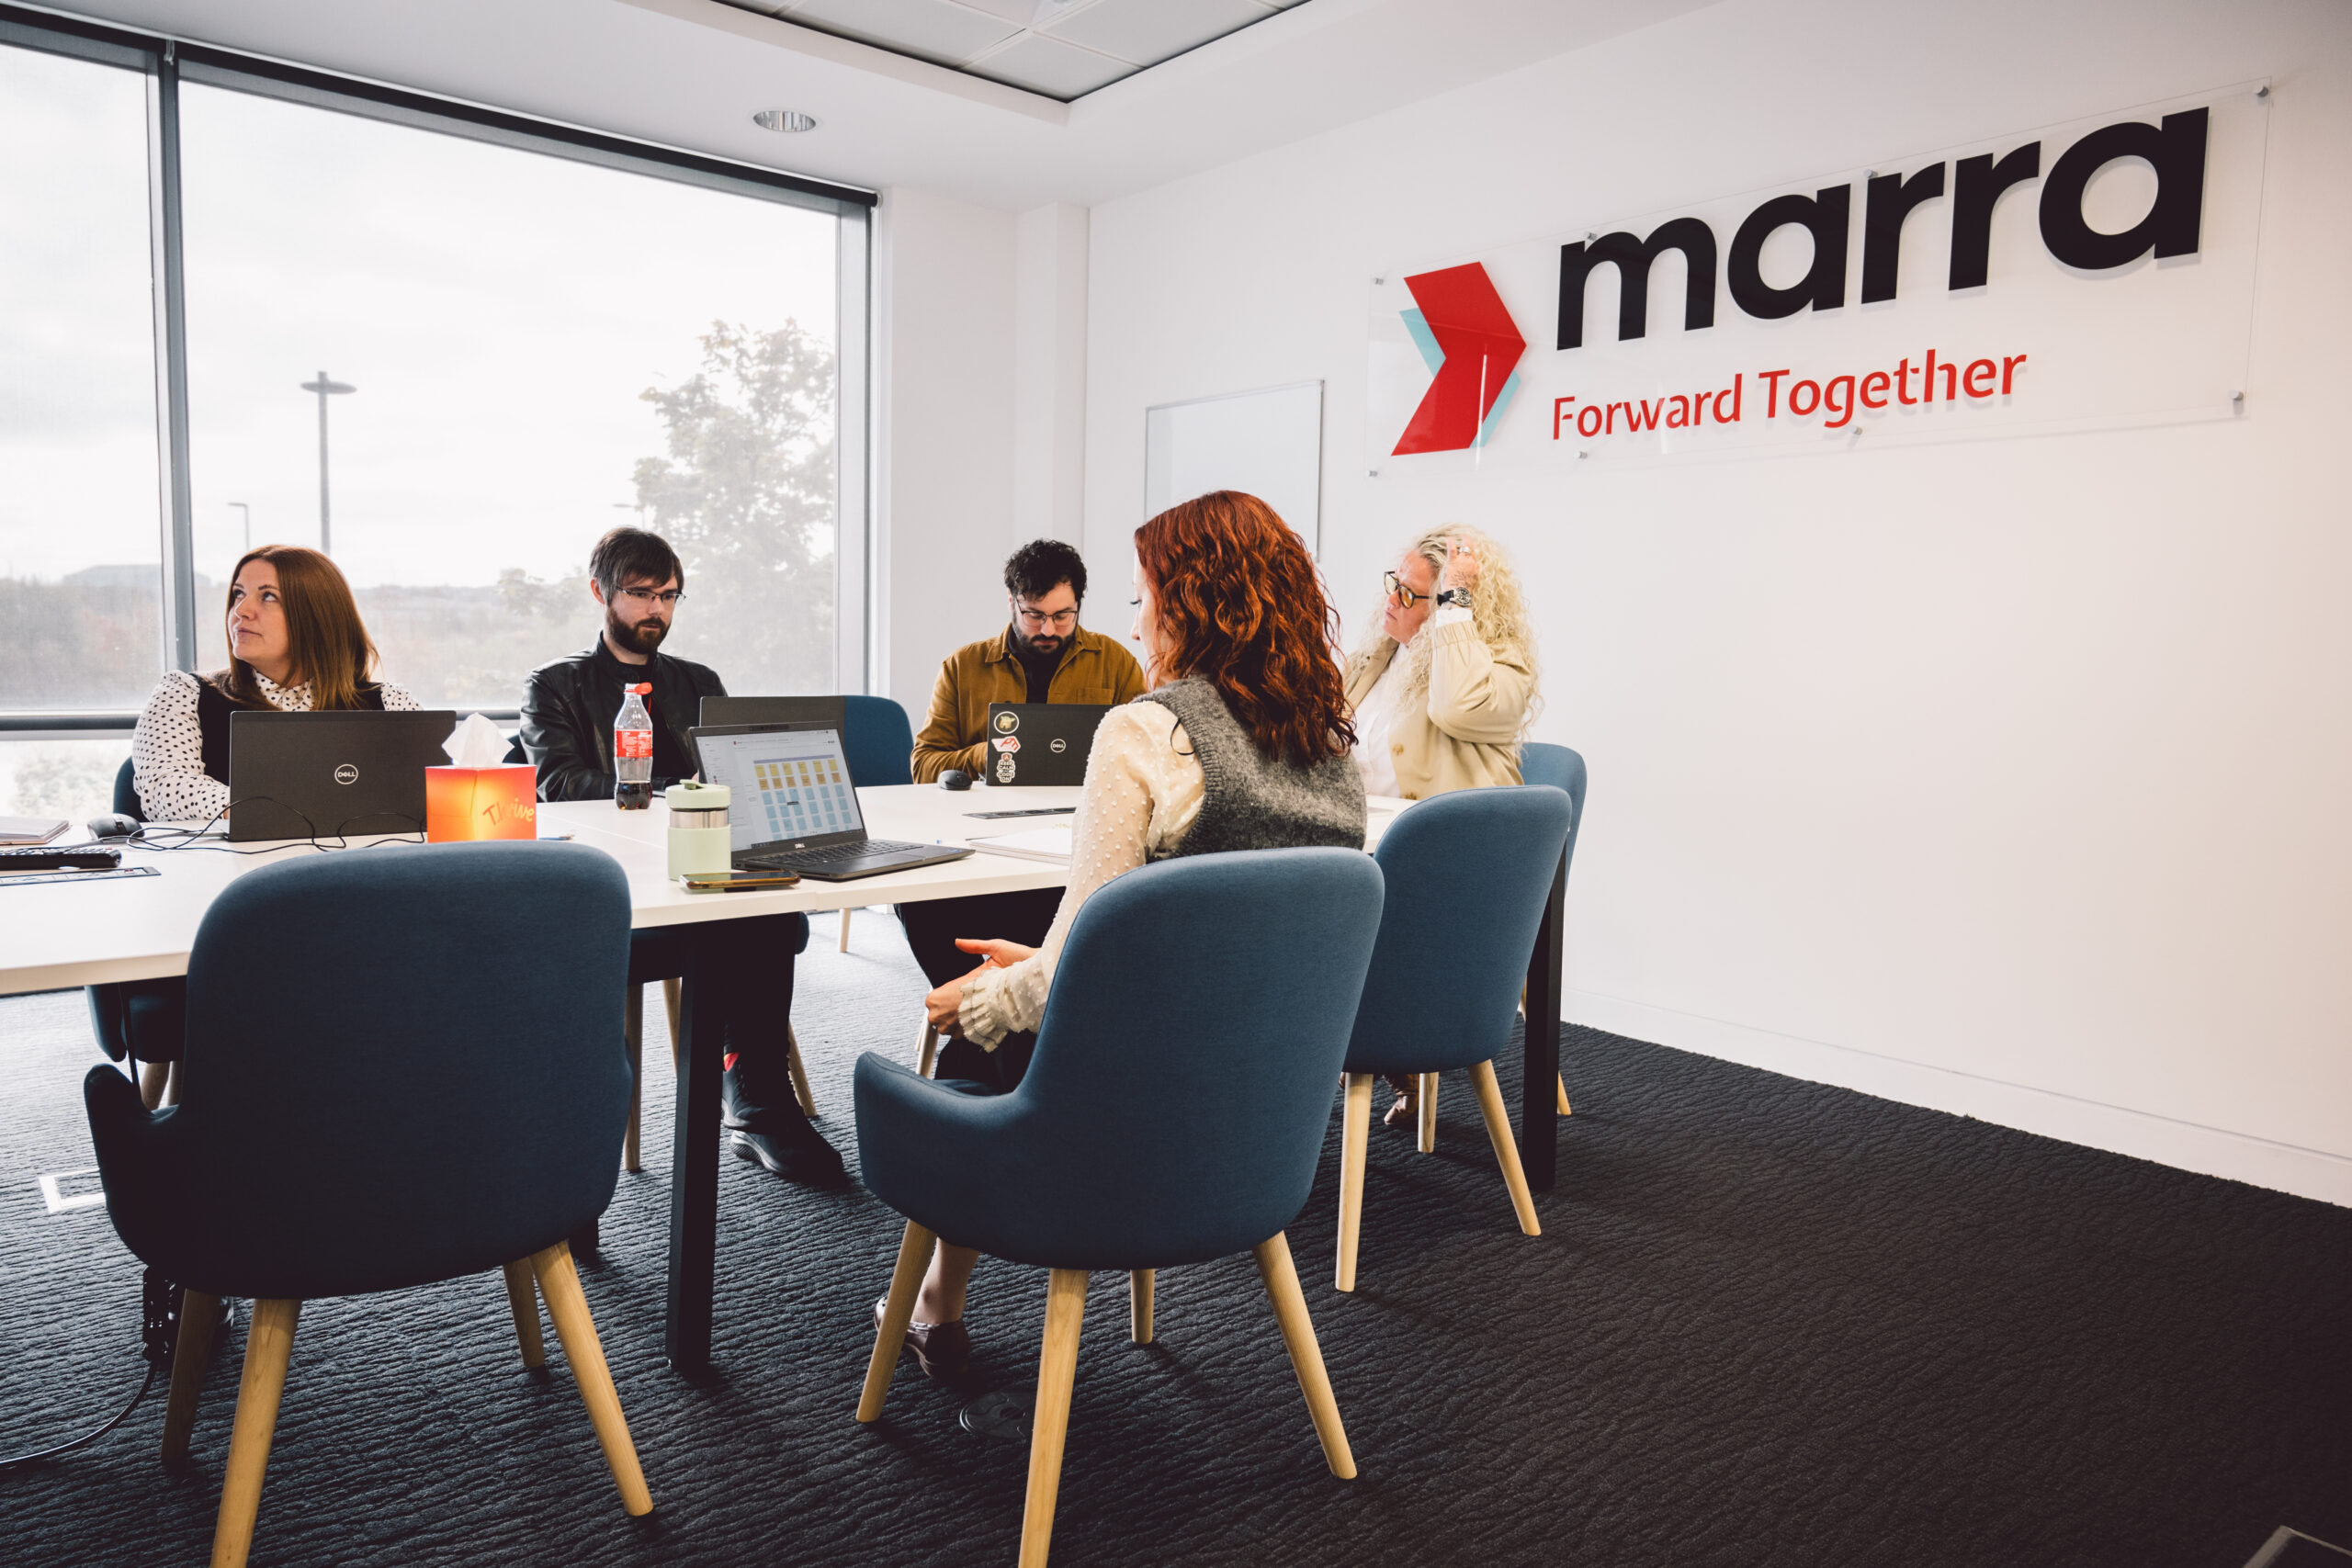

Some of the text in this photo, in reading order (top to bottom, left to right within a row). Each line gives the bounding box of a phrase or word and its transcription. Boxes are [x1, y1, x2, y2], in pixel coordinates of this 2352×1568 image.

[1556, 106, 2210, 351] marra
[1553, 348, 2028, 440] Forward Together
